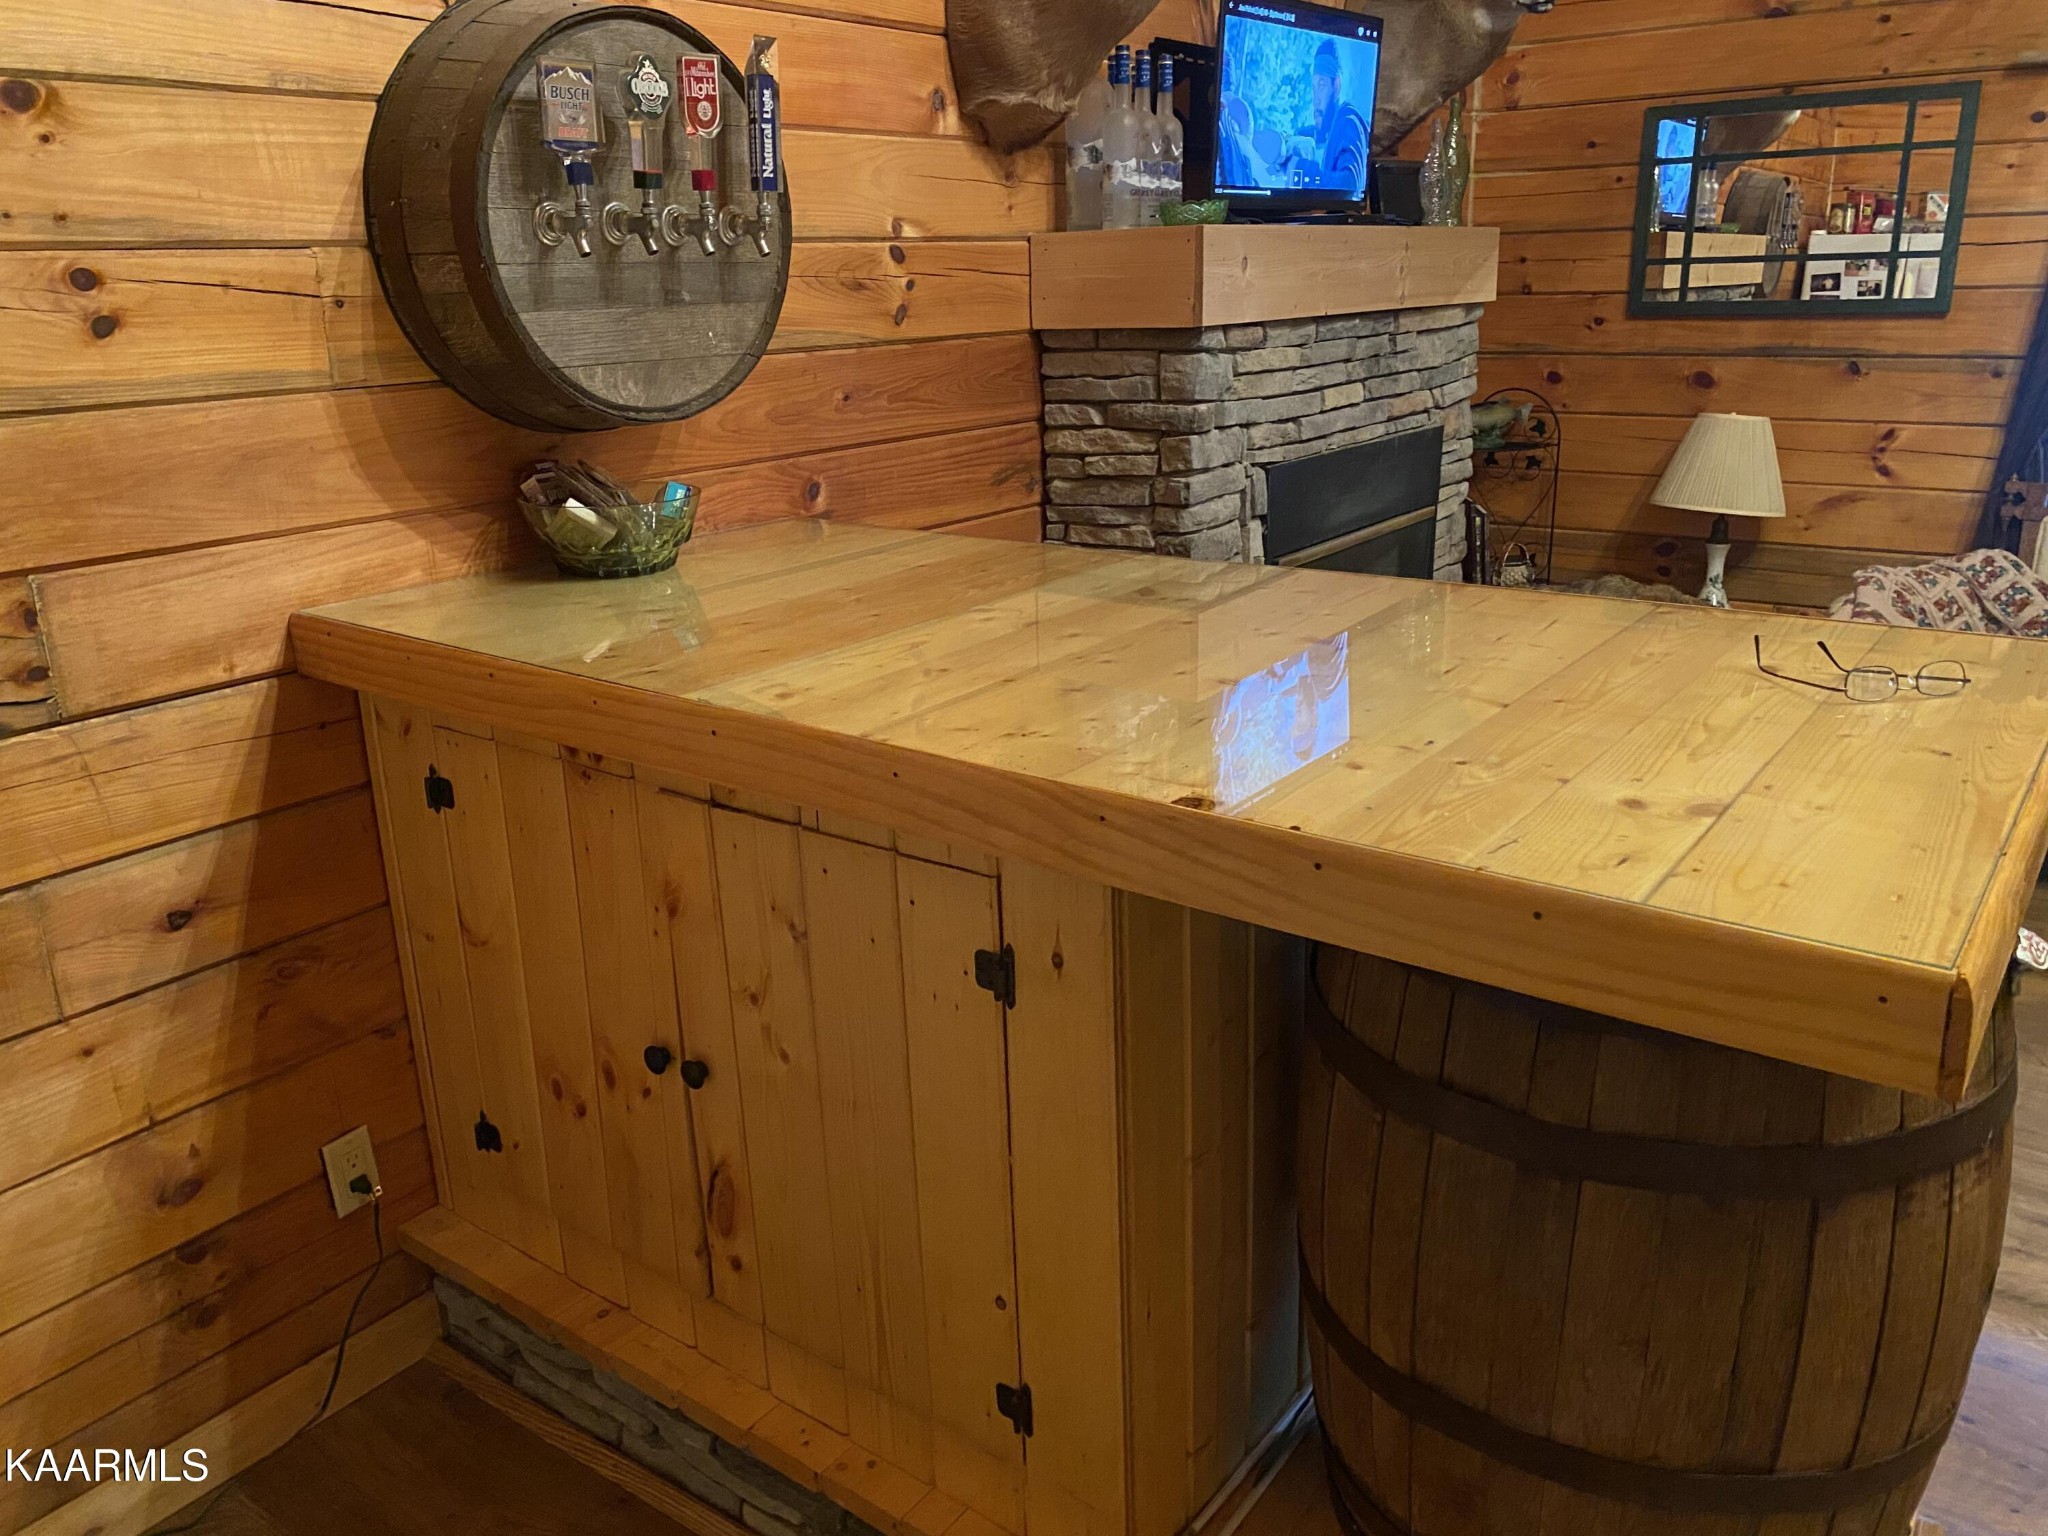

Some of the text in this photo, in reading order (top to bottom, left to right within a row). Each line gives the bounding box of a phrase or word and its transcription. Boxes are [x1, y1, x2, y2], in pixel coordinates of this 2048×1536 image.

[550, 85, 589, 101] BUSCH
[690, 77, 716, 99] Light
[560, 102, 582, 111] LIGHT
[761, 88, 774, 178] Natural Light
